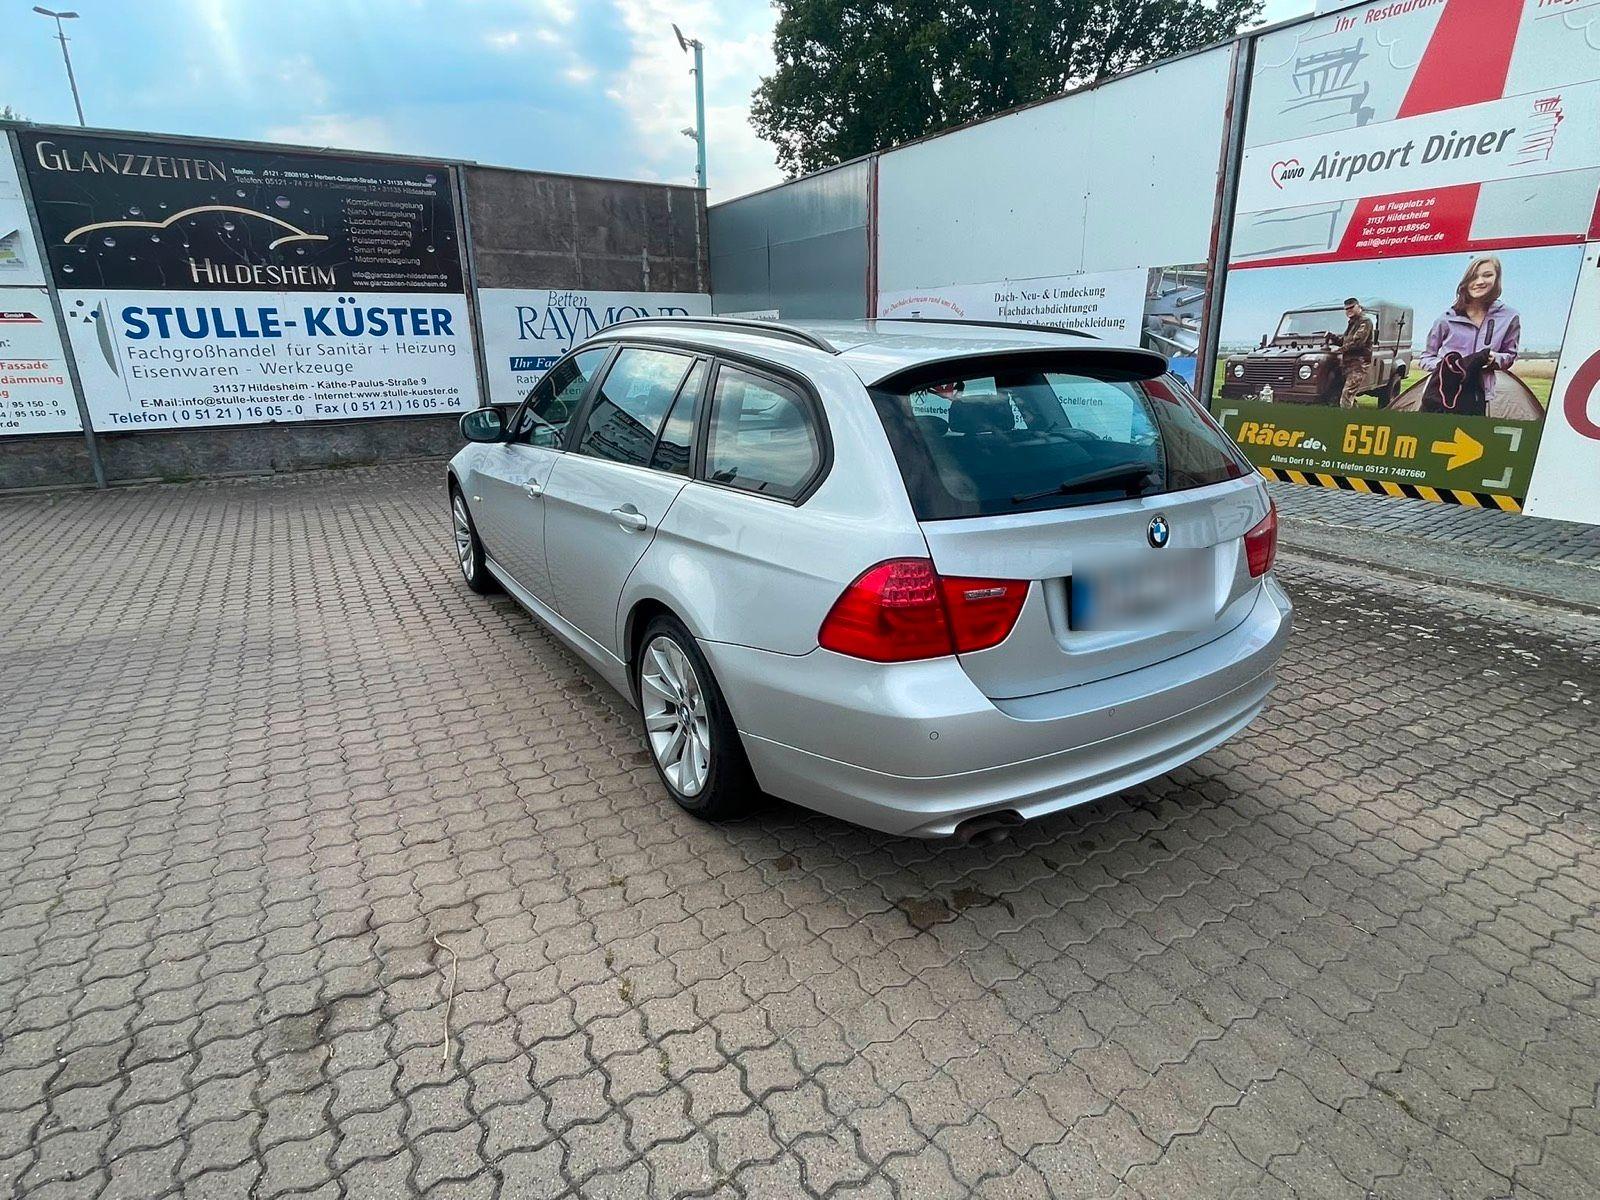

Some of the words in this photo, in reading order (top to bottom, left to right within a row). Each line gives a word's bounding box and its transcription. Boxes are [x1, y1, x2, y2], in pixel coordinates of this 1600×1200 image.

[1335, 16, 1357, 32] Ihr
[35, 140, 227, 182] GLANZZEITEN
[1309, 140, 1414, 182] Airport
[1421, 128, 1516, 164] Diner
[314, 174, 377, 184] Herbert-Quandt-Straße
[404, 180, 432, 188] Hildesheim
[1280, 167, 1304, 180] AWO
[402, 186, 437, 197] Hildesheim
[1373, 203, 1386, 212] Am
[1387, 199, 1424, 211] Flugplatz
[347, 207, 368, 216] Nano
[369, 208, 416, 220] Versiegelung
[1366, 215, 1385, 226] 31137
[1387, 210, 1430, 222] Hildesheim
[350, 226, 412, 239] Ozonbehandlung
[1362, 226, 1375, 236] Tel:
[1377, 226, 1396, 235] 05121
[352, 236, 411, 247] Polsterreinigung
[1355, 232, 1445, 248] mail@airport-diner.de
[353, 245, 375, 254] Smart
[355, 255, 421, 266] Motorversiegelung
[188, 257, 337, 286] HILDESHEIM
[547, 290, 588, 307] Betten
[994, 292, 1018, 303] Dach-
[1020, 289, 1040, 301] Neu-
[1042, 288, 1051, 300] &
[1053, 286, 1106, 299] Umdeckung
[998, 303, 1099, 317] Flachdachabdichtungen
[127, 343, 276, 362] Fachgroßhandel
[286, 343, 311, 357] für
[317, 342, 373, 356] Sanitär
[396, 342, 456, 356] Heizung
[0, 361, 49, 370] Fassade
[132, 363, 239, 379] Eisenwaren
[259, 361, 354, 376] Werkzeuge
[513, 357, 533, 369] Ihr
[213, 384, 246, 394] 31137
[248, 381, 309, 393] Hildesheim
[317, 378, 419, 390] Käthe-Paulus-Straße
[421, 377, 427, 386] 9
[27, 400, 44, 408] 150
[109, 411, 168, 424] Telefon
[315, 403, 339, 414] Fax
[1237, 421, 1322, 452] Räer.de
[1342, 423, 1391, 457] 650
[1394, 434, 1418, 459] m
[1270, 454, 1288, 464] Altes
[1289, 456, 1304, 466] Dorf
[1305, 459, 1314, 467] 18
[1336, 462, 1364, 473] Telefon
[1365, 465, 1389, 475] 05121
[1390, 467, 1426, 479] 7487660
